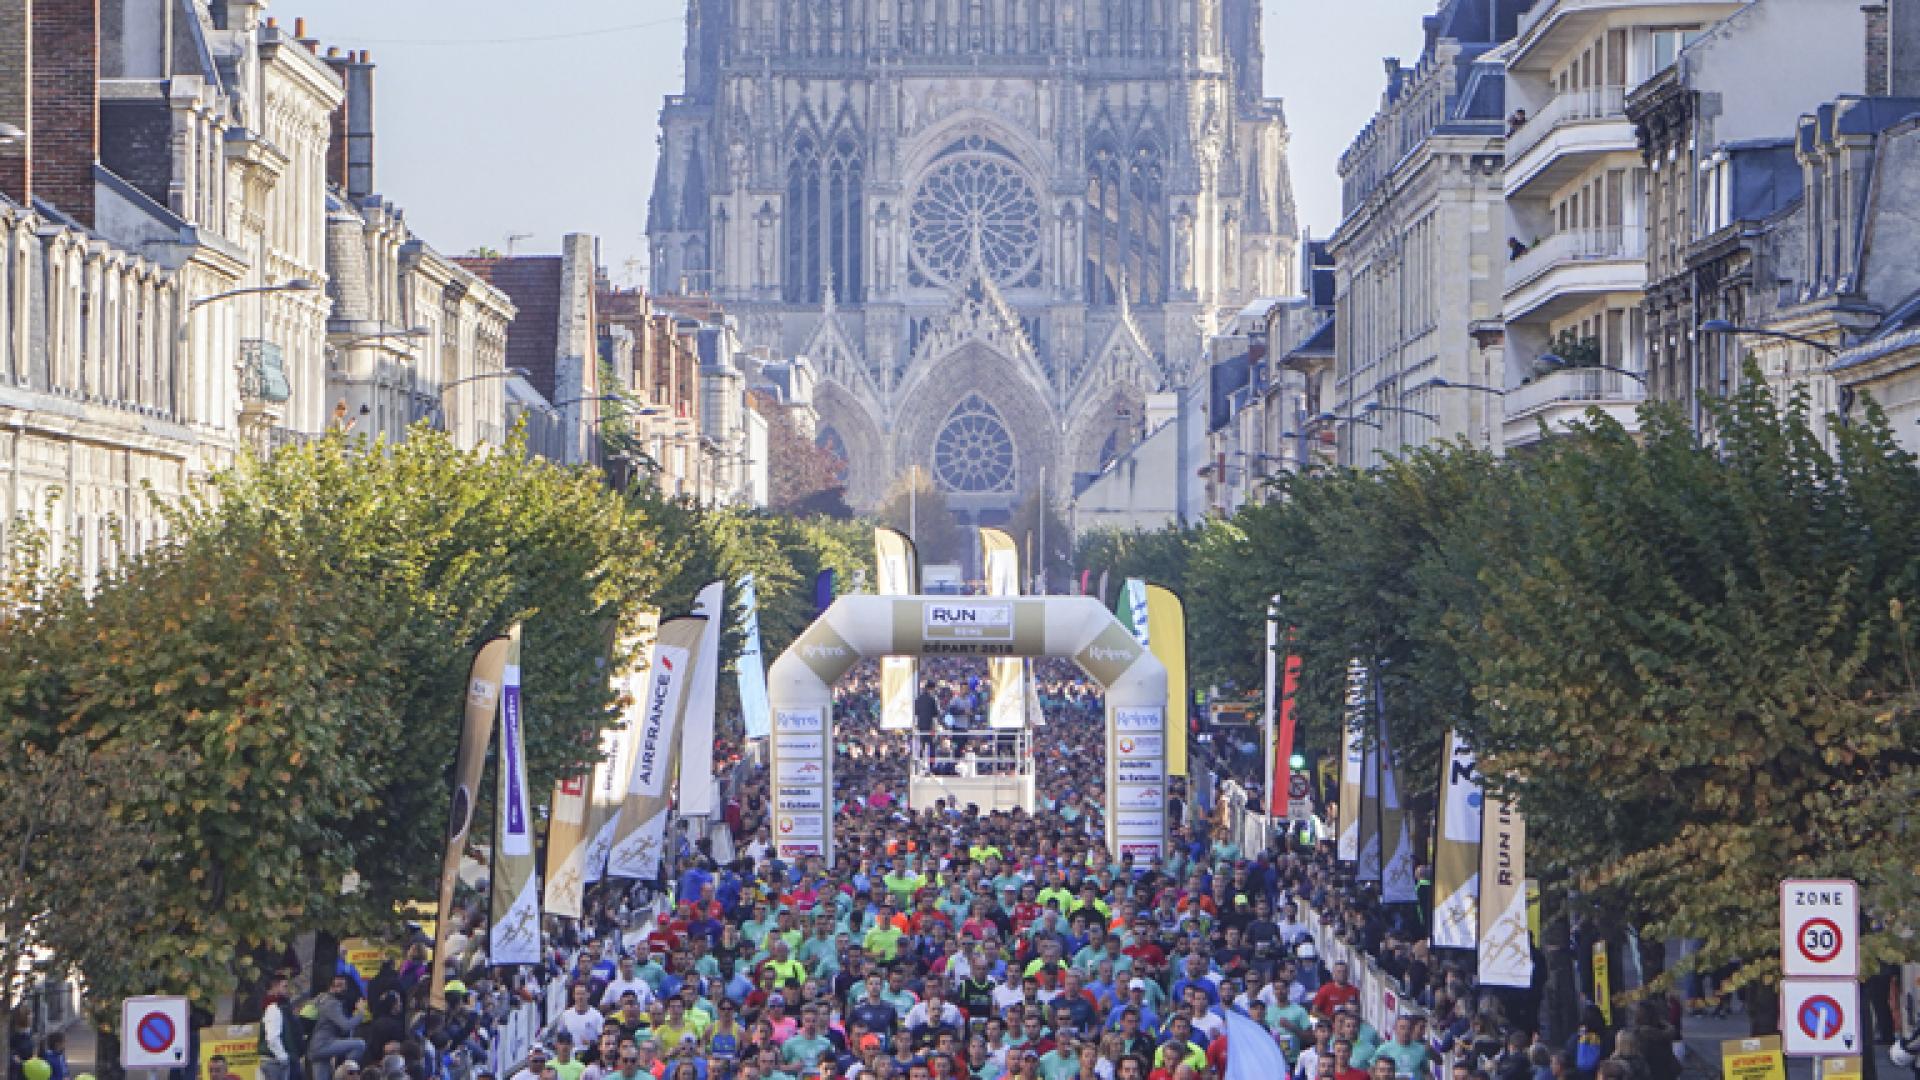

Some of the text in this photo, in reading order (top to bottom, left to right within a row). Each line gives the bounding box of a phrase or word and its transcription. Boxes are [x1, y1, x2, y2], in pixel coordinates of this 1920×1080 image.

[932, 608, 976, 621] RUN
[1498, 831, 1512, 886] RUN
[1795, 891, 1843, 906] ZONE
[1806, 929, 1834, 950] 30
